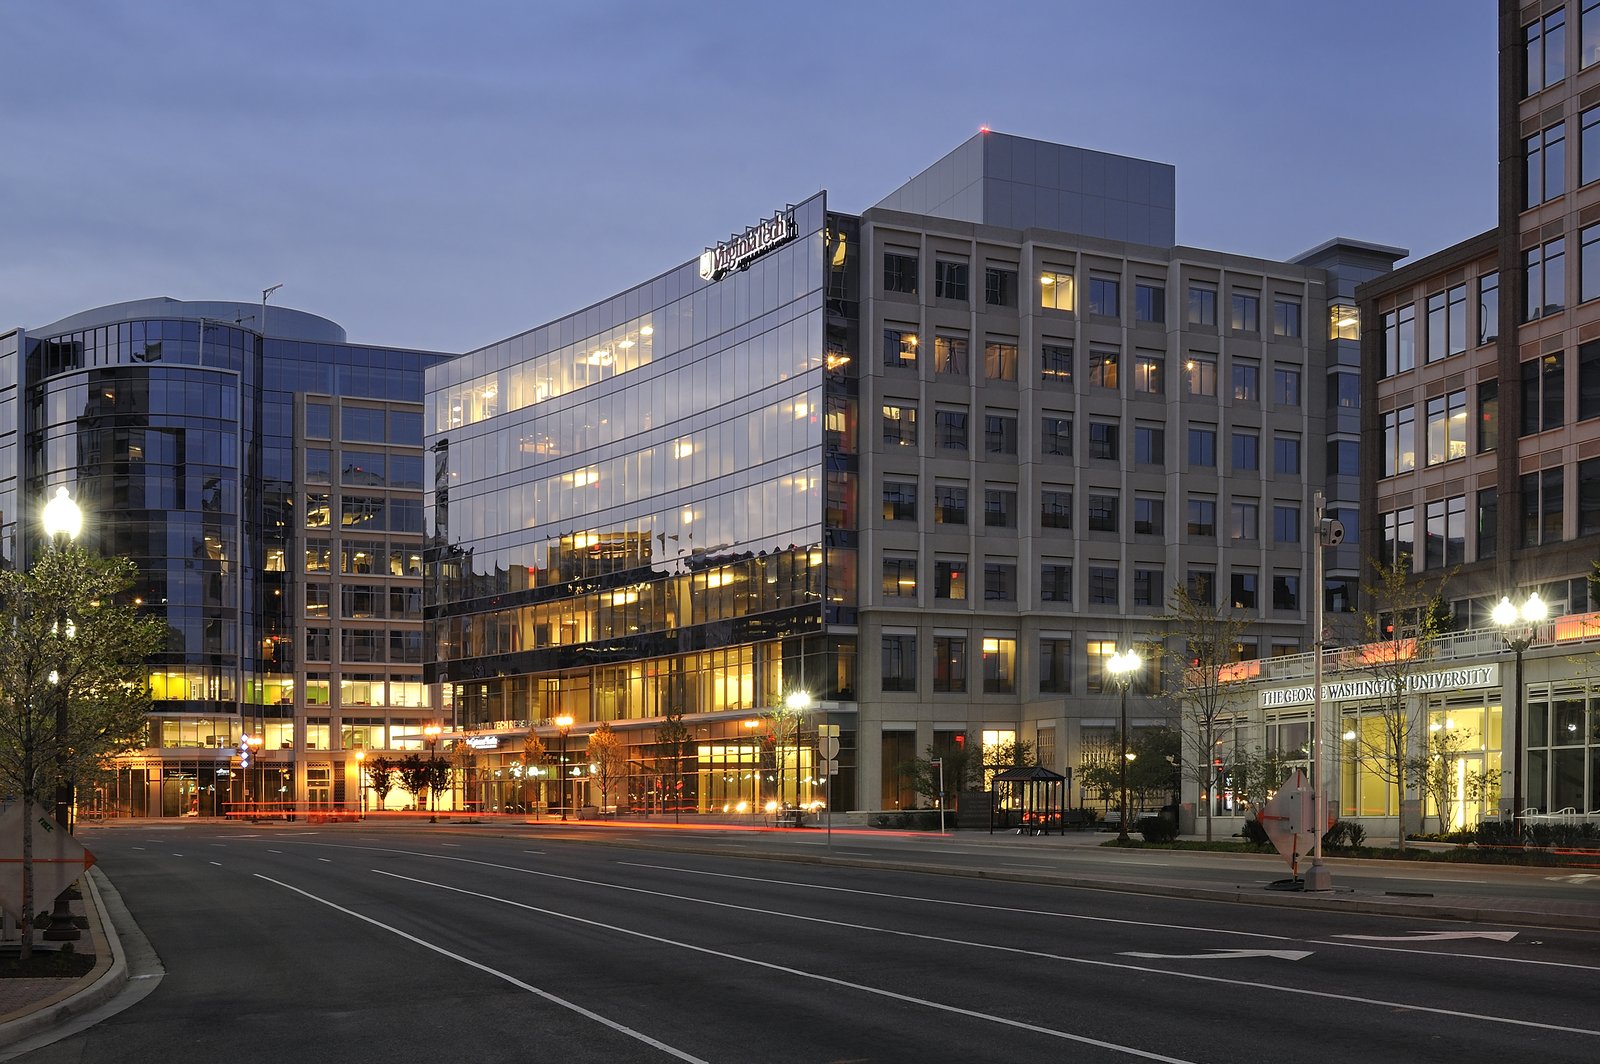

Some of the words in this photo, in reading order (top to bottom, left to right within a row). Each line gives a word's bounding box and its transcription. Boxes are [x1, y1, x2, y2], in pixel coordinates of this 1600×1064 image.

[1262, 690, 1284, 705] THE
[1284, 684, 1328, 703] GEORE
[1410, 667, 1492, 691] UNIVERSITY
